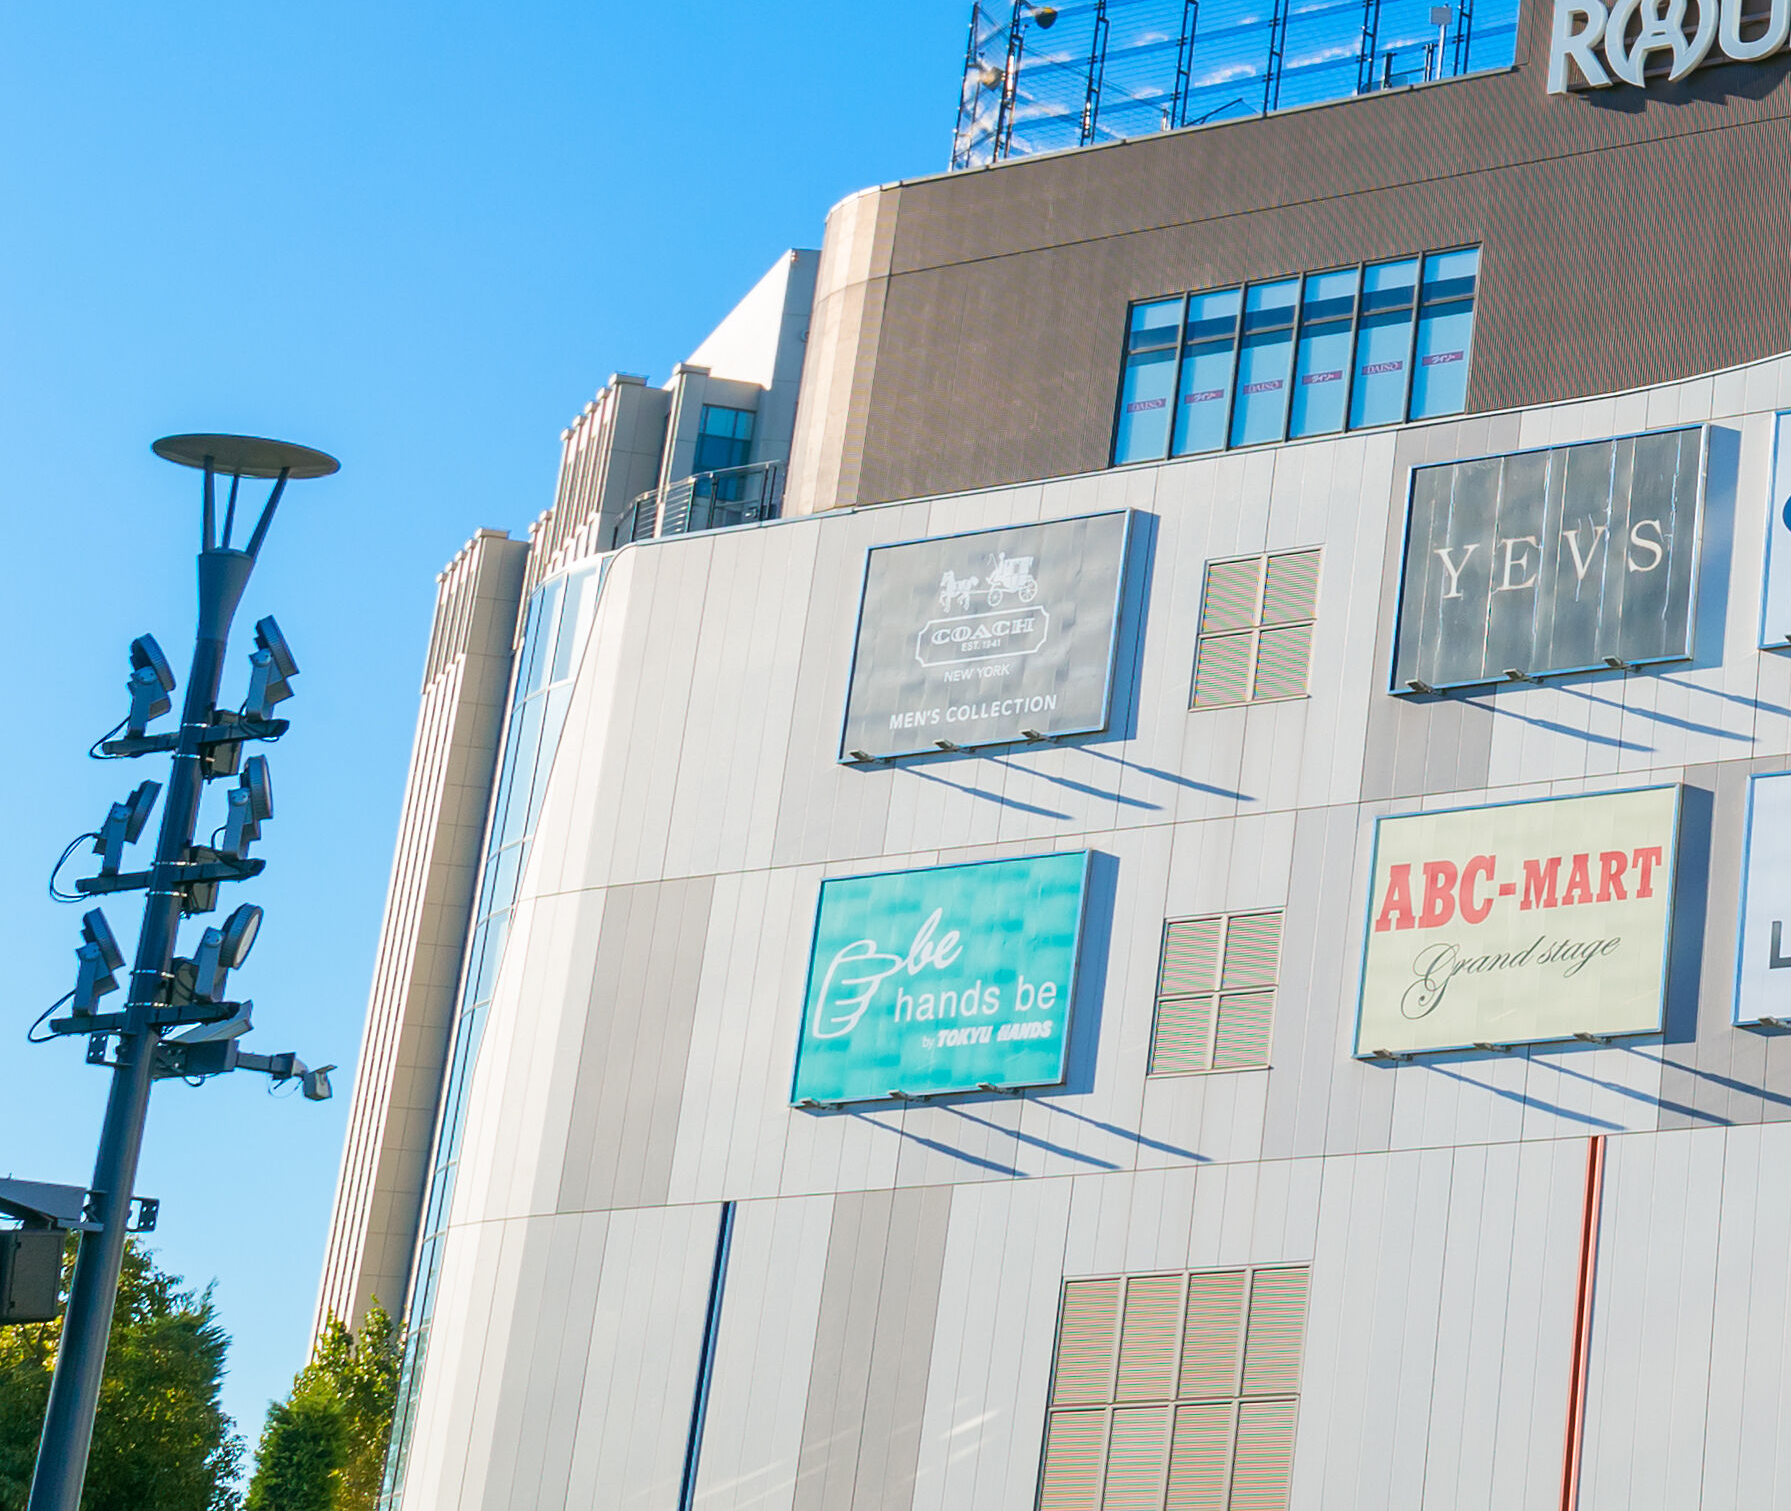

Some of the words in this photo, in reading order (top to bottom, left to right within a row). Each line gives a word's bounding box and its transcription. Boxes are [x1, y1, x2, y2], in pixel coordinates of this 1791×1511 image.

[1367, 362, 1399, 374] DAISO
[1433, 519, 1665, 600] YEVS
[931, 617, 1035, 645] COACH
[944, 667, 975, 683] NEW
[977, 663, 1011, 678] YORK
[889, 707, 940, 730] MEN'S
[946, 694, 1057, 722] COLLECTION
[1374, 846, 1663, 933] ABC-MART
[901, 907, 964, 976] be
[1400, 935, 1545, 1020] Grand
[1537, 937, 1622, 978] stage
[894, 979, 1001, 1023] hands
[1014, 975, 1057, 1012] be
[937, 1025, 990, 1048] TOKYU
[997, 1020, 1053, 1042] HANDS
